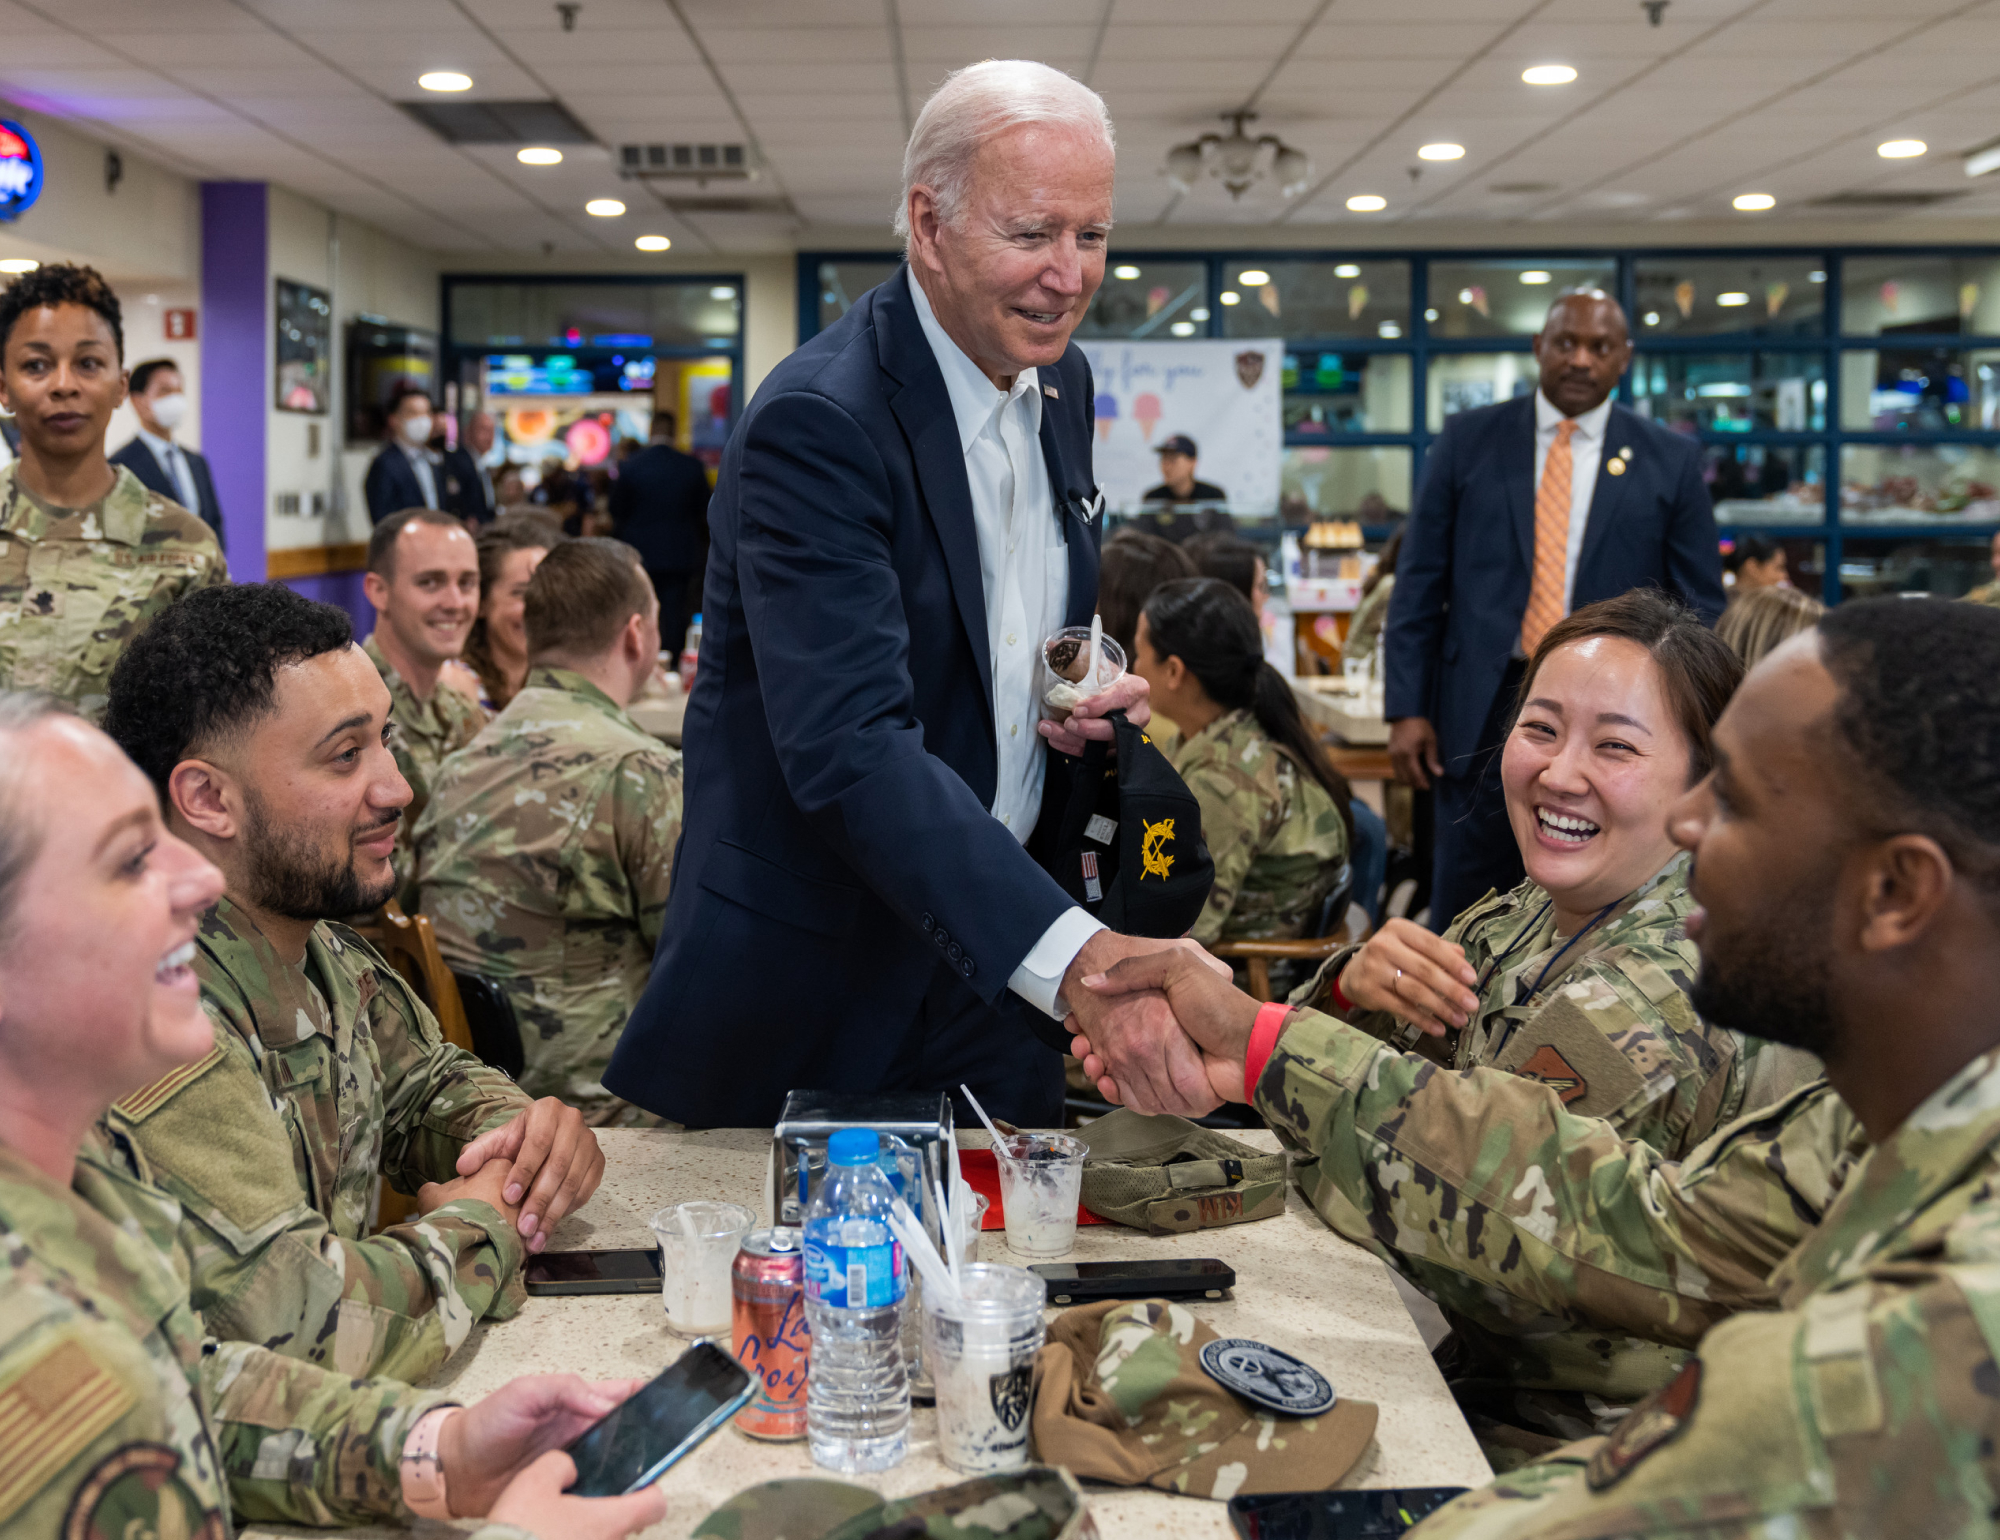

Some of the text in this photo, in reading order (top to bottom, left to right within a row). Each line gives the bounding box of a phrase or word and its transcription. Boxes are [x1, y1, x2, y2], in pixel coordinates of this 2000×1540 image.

[1121, 348, 1154, 391] for
[1165, 365, 1203, 391] you
[1197, 1193, 1244, 1222] KIM
[766, 1290, 811, 1352] La
